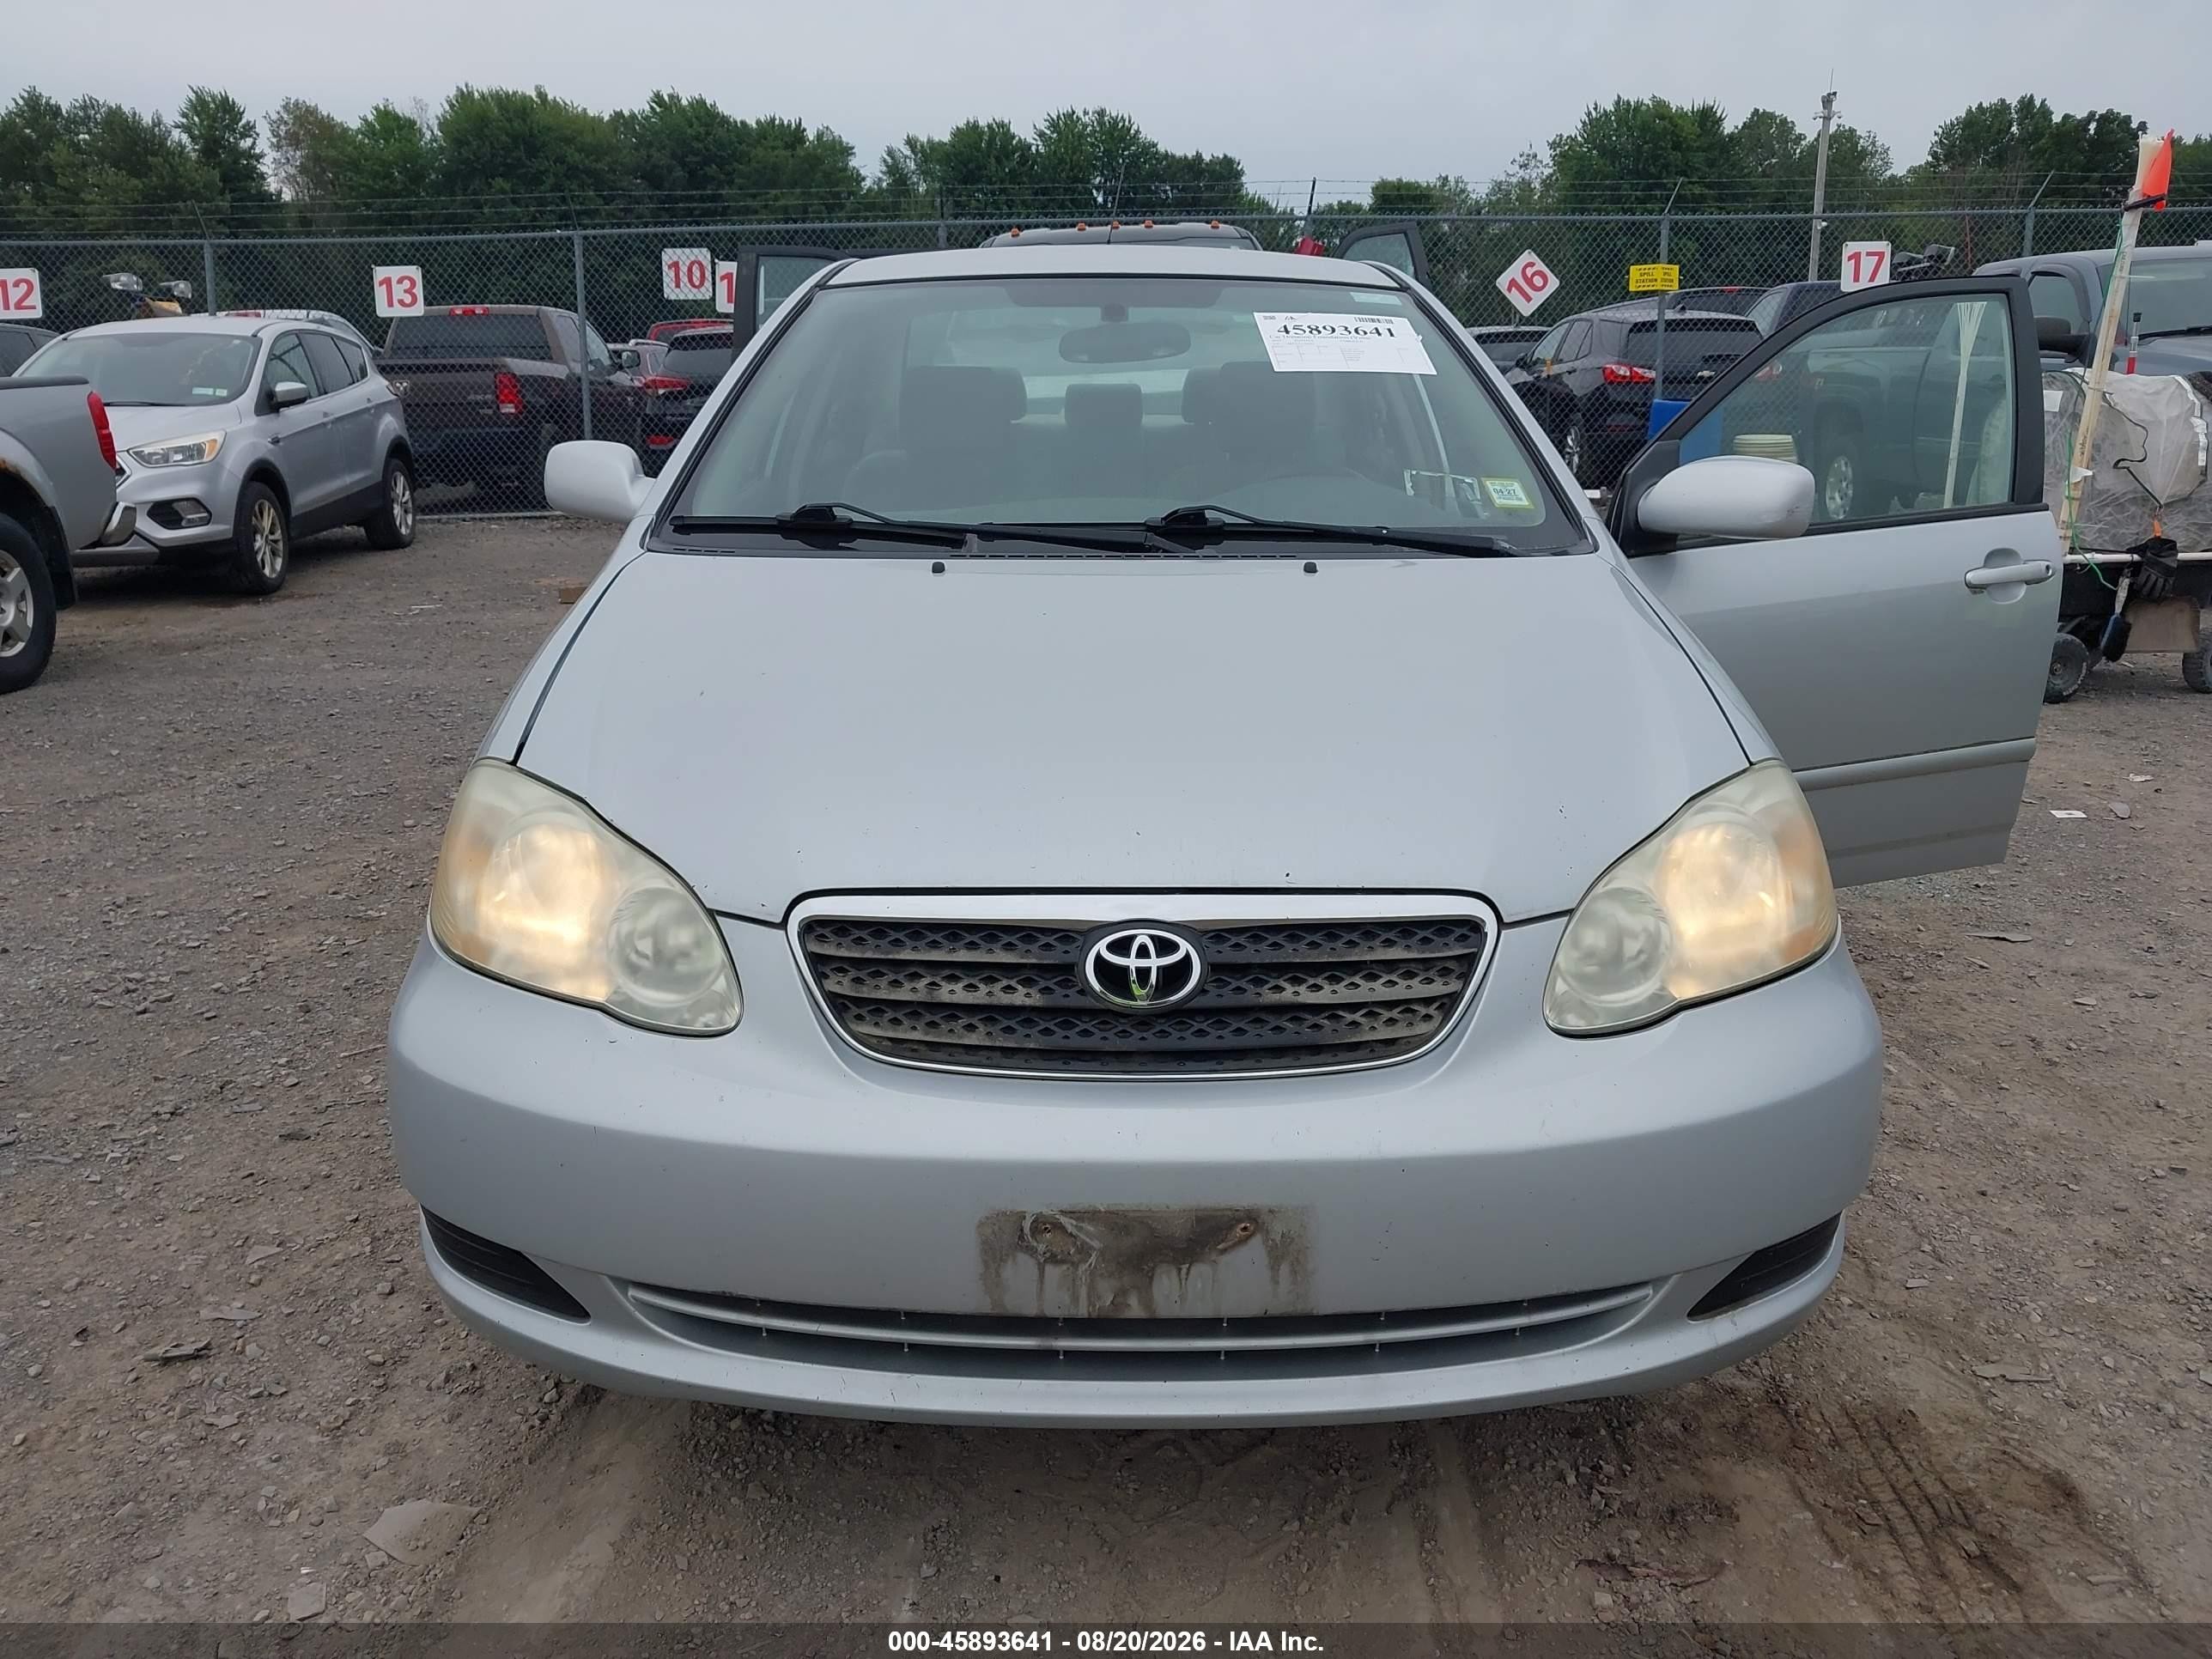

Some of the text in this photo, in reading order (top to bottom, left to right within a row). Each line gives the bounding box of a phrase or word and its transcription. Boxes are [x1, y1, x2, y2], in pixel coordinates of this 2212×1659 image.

[667, 259, 706, 289] 10
[1506, 261, 1549, 304] 16
[1847, 251, 1886, 283] 17
[0, 277, 37, 311] 12
[379, 275, 418, 308] 13
[720, 271, 735, 304] 1
[1277, 324, 1396, 337] 45893641
